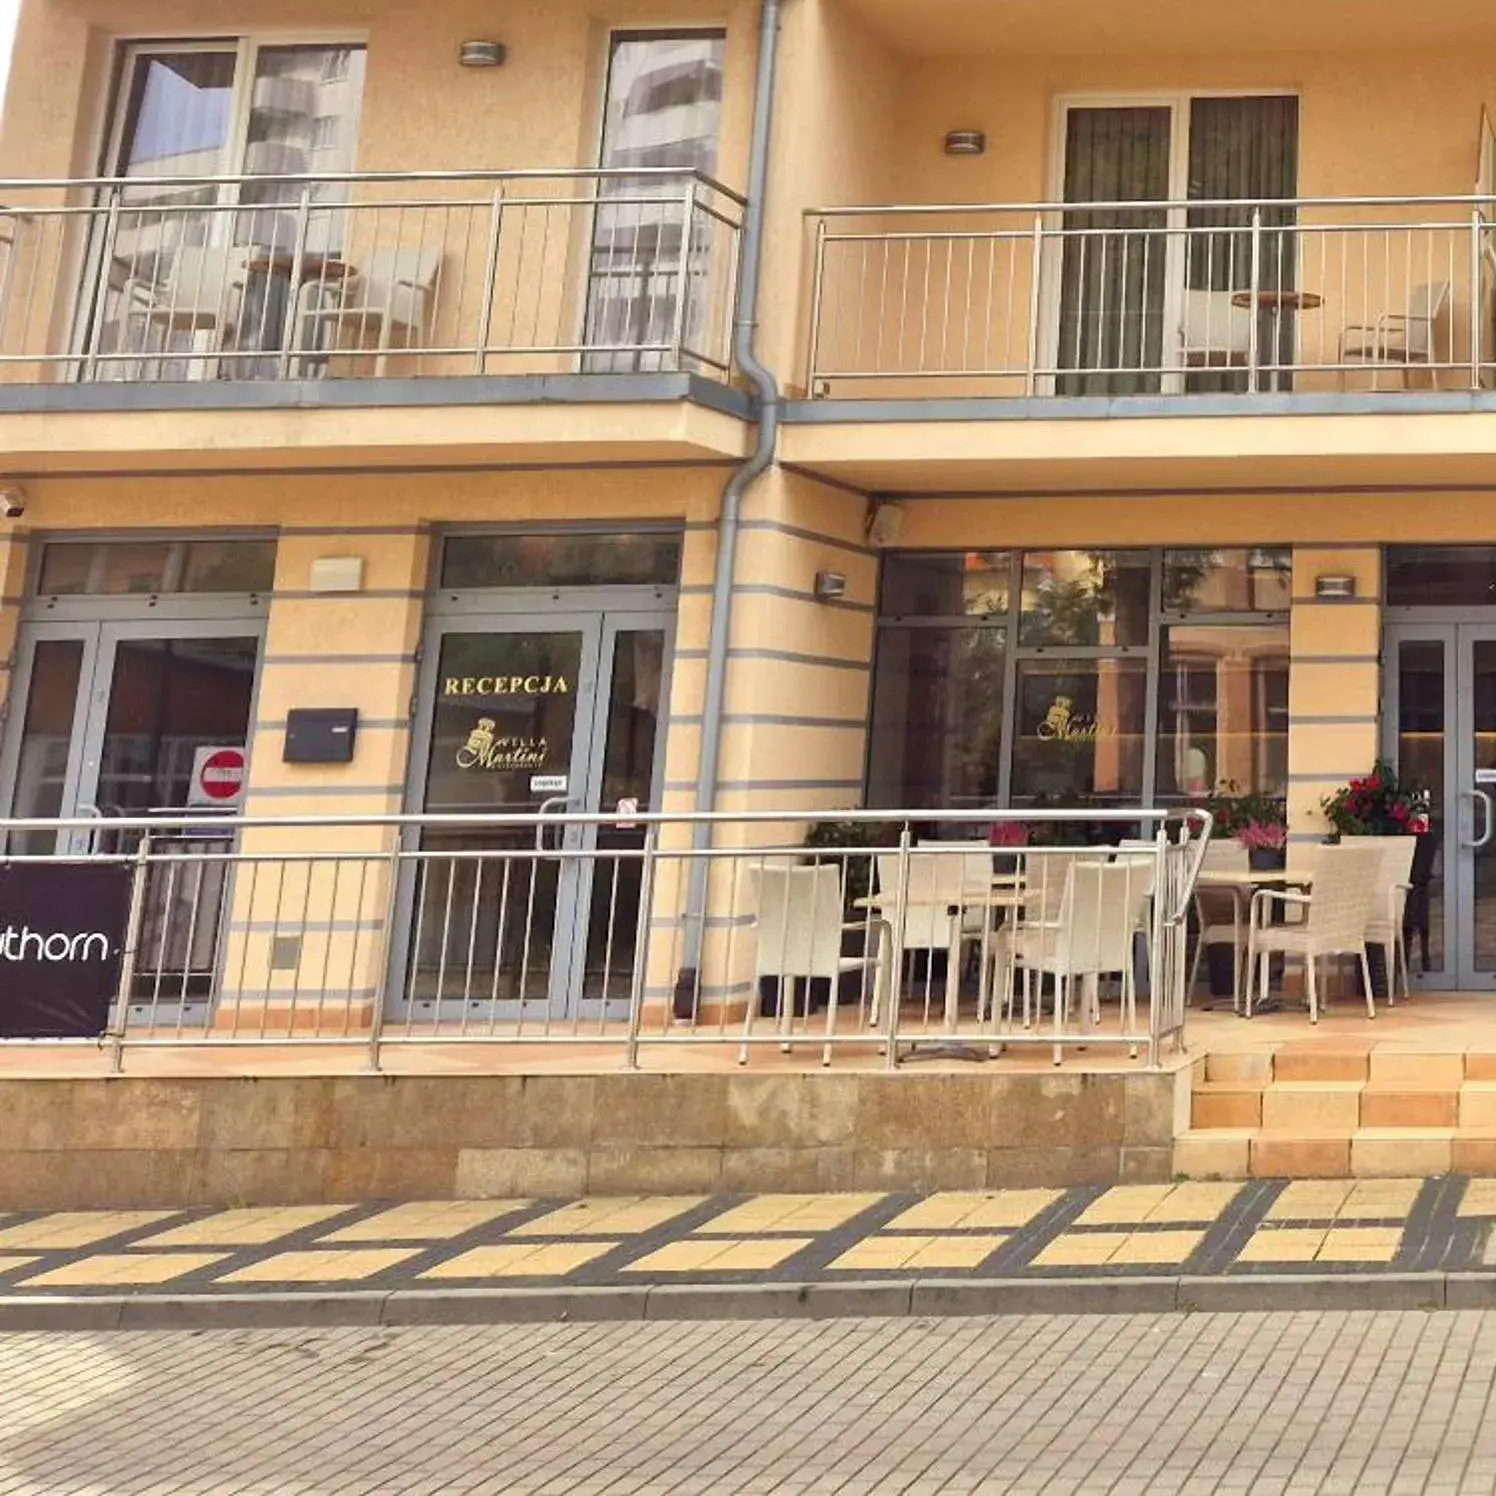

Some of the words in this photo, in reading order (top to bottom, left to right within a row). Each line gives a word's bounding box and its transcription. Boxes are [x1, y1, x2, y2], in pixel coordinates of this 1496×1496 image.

[444, 676, 568, 695] RECEPCJA
[499, 737, 548, 747] VILLA
[456, 742, 549, 769] Martini
[0, 925, 109, 961] thorn
